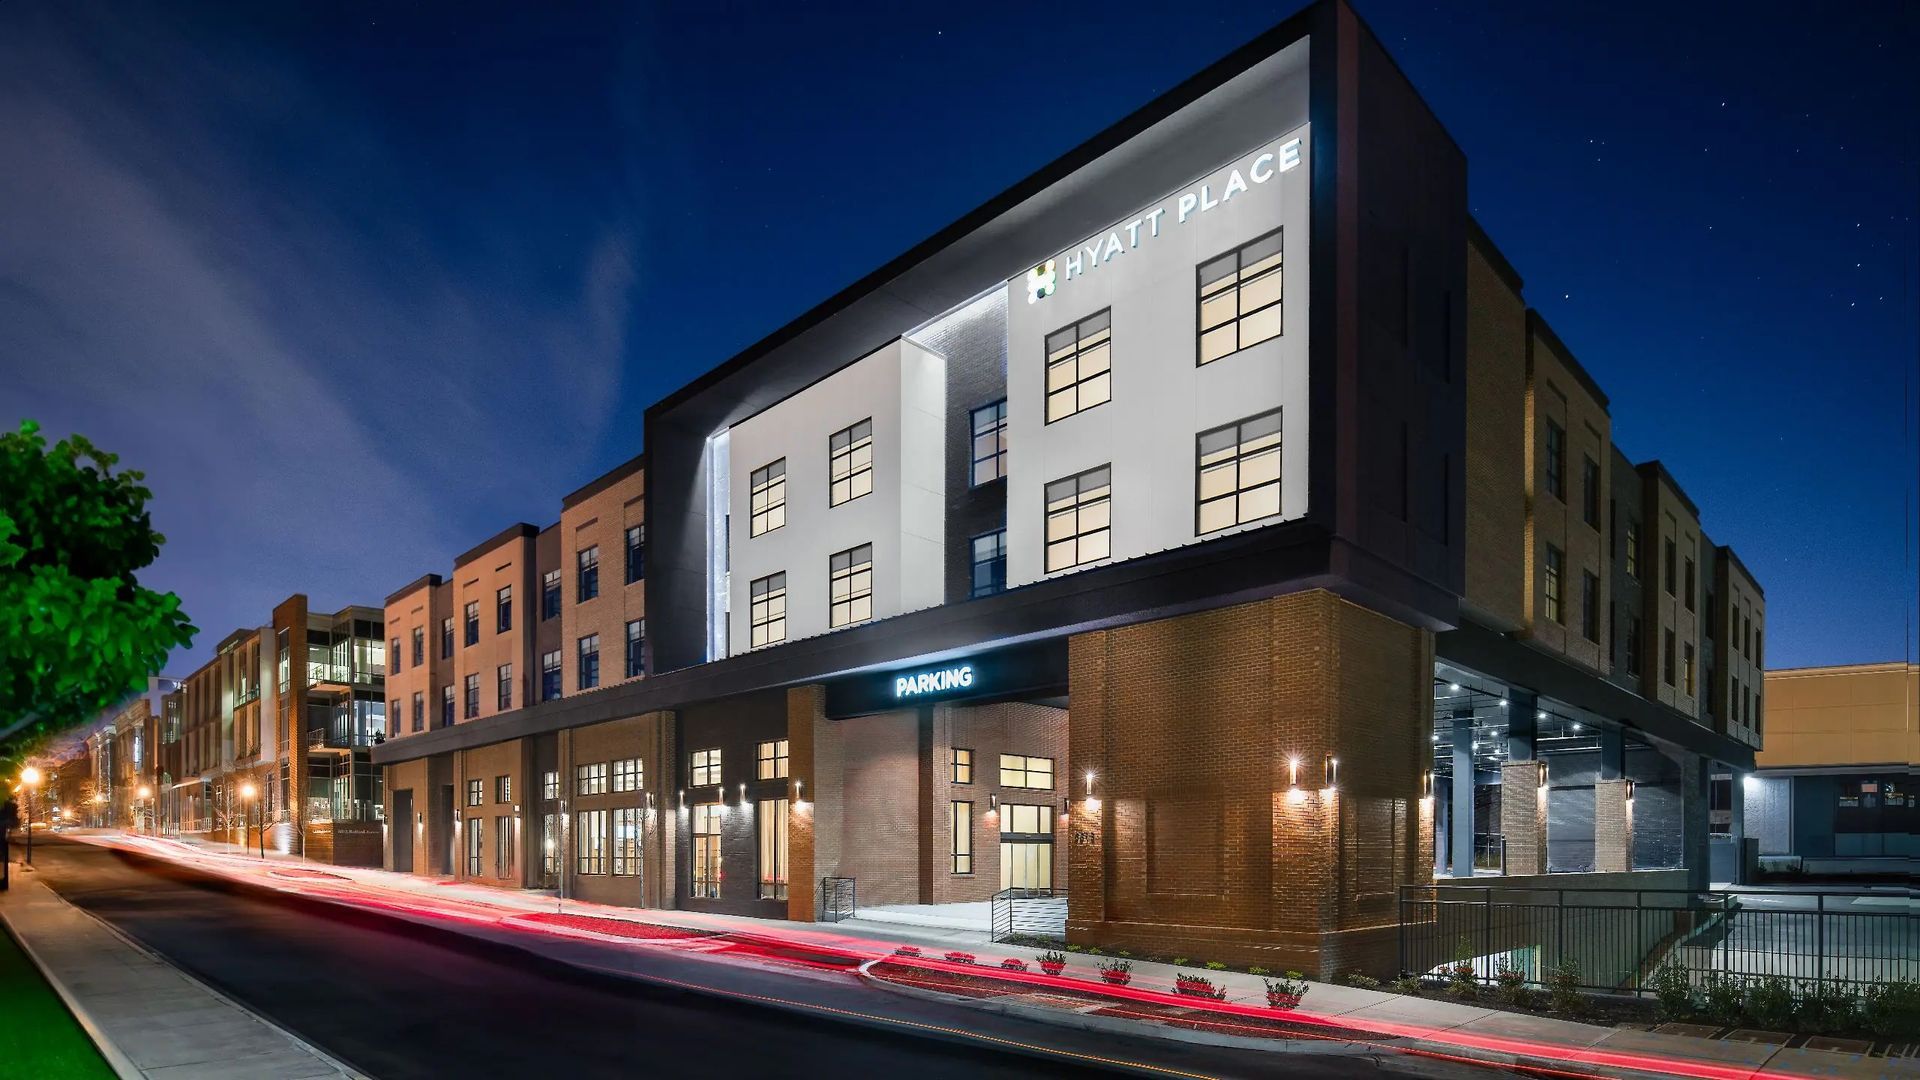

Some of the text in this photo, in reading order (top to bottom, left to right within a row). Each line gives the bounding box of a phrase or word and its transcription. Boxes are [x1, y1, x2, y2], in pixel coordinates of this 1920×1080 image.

[1065, 137, 1302, 280] HYATT PLACE
[896, 666, 972, 697] PARKING
